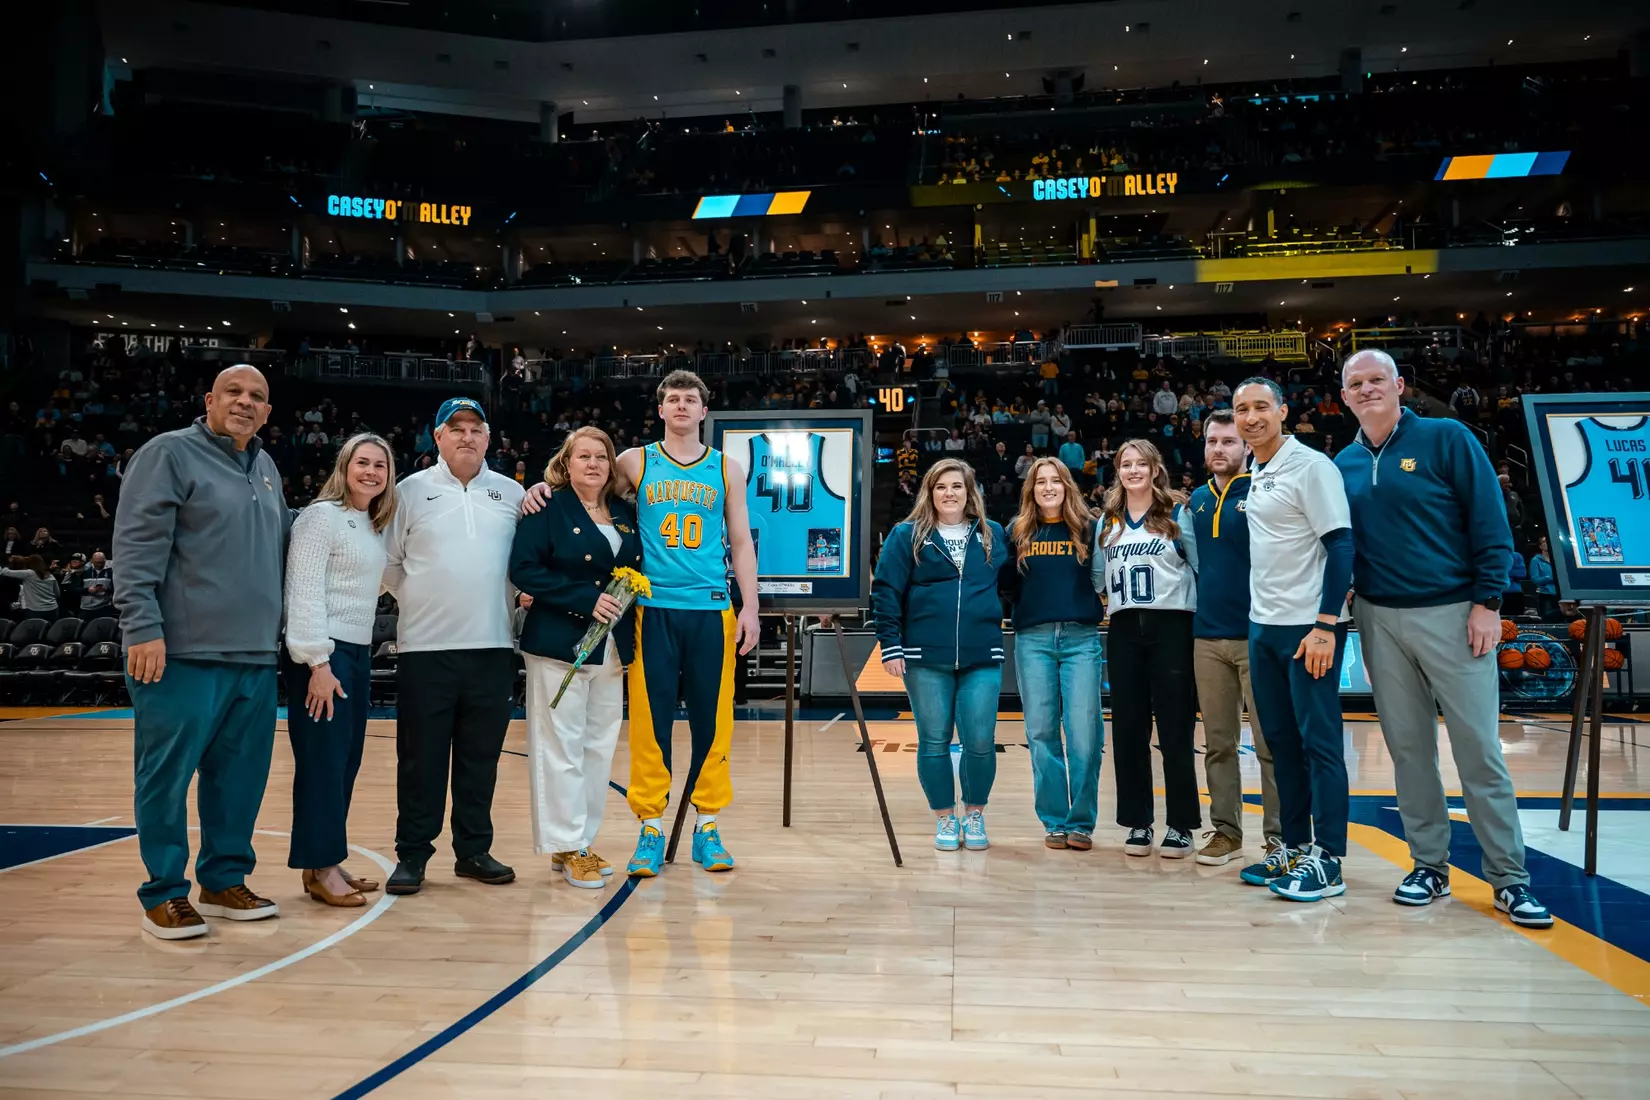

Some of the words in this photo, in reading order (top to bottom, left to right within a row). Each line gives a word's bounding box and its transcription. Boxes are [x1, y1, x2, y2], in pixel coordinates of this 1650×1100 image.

[1032, 176, 1089, 201] CASEY
[1089, 172, 1178, 198] O'MALLEY
[327, 194, 385, 219] CASEY
[385, 199, 472, 226] O'MALLEY
[988, 293, 1001, 303] 117
[1217, 284, 1231, 293] 117
[878, 387, 904, 413] 40
[1605, 439, 1647, 452] LUCAS
[645, 479, 718, 510] MARQUETTE
[756, 472, 814, 512] 40
[659, 512, 703, 550] 40
[1026, 541, 1074, 556] RQUET
[1111, 563, 1155, 605] 40
